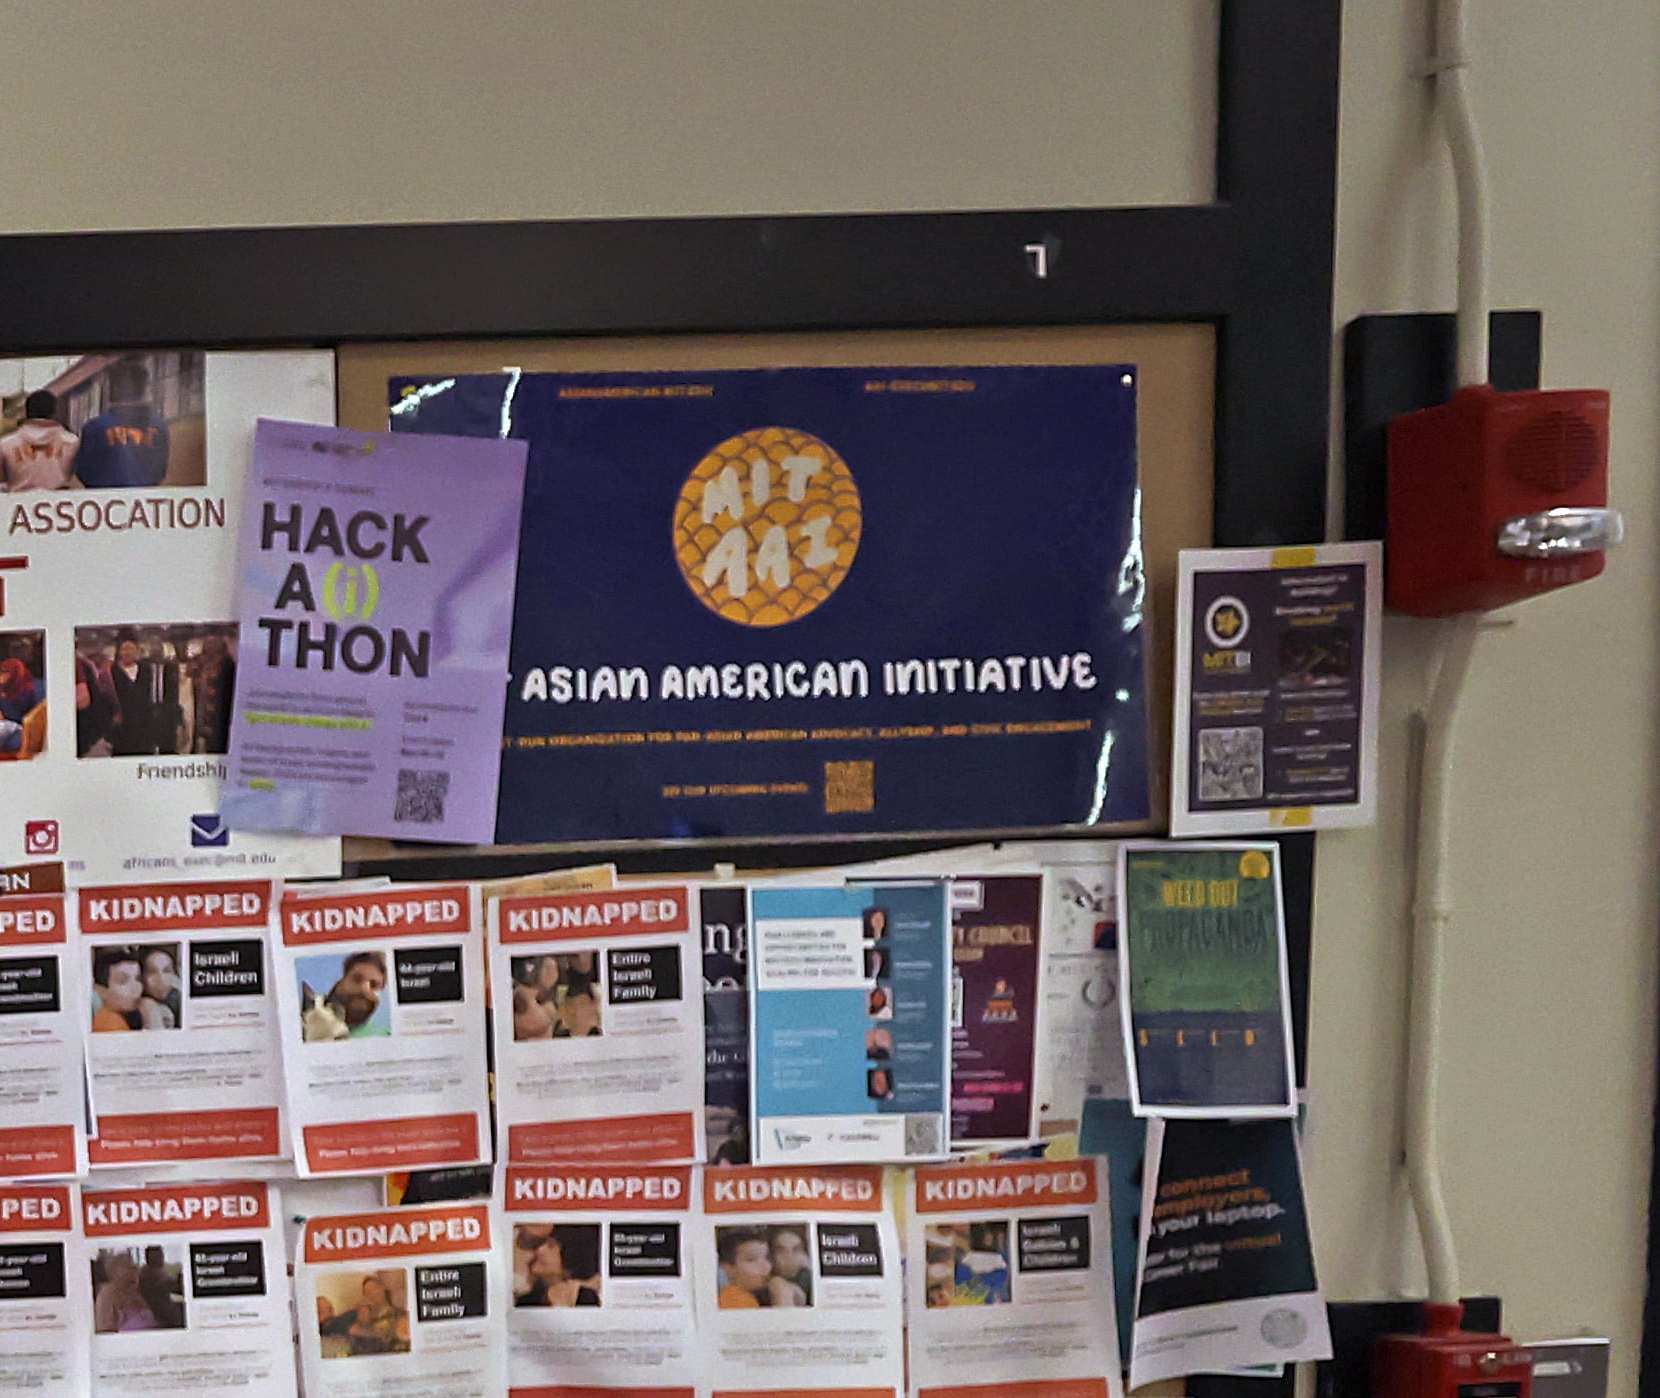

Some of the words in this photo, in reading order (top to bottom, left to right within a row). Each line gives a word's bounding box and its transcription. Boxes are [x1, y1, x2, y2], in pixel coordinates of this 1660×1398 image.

[702, 457, 822, 523] MIT
[9, 499, 227, 535] ASSOCATION
[260, 500, 430, 563] HACK
[704, 518, 840, 598] AAI
[258, 618, 431, 677] THON
[522, 666, 649, 702] ASIAN
[660, 659, 869, 701] AMERICAN
[884, 652, 1097, 696] INITIATIVE
[1208, 879, 1239, 908] OUT
[88, 894, 262, 923] KIDNAPPED
[291, 901, 462, 935] KIDNAPPED
[507, 899, 679, 933] KIDNAPPED
[193, 952, 240, 969] Israeli
[611, 952, 652, 967] Entire
[195, 969, 258, 987] Children
[612, 969, 653, 983] Israeli
[613, 984, 658, 1001] Family
[514, 1177, 681, 1203] KIDNAPPED
[713, 1178, 873, 1203] KIDNAPPED
[923, 1167, 1089, 1202] KIDNAPPED
[87, 1195, 260, 1225] KIDNAPPED
[312, 1216, 482, 1251] KIDNAPPED
[821, 1233, 859, 1247] Israeli
[821, 1251, 877, 1266] Children
[422, 1301, 466, 1318] Family
